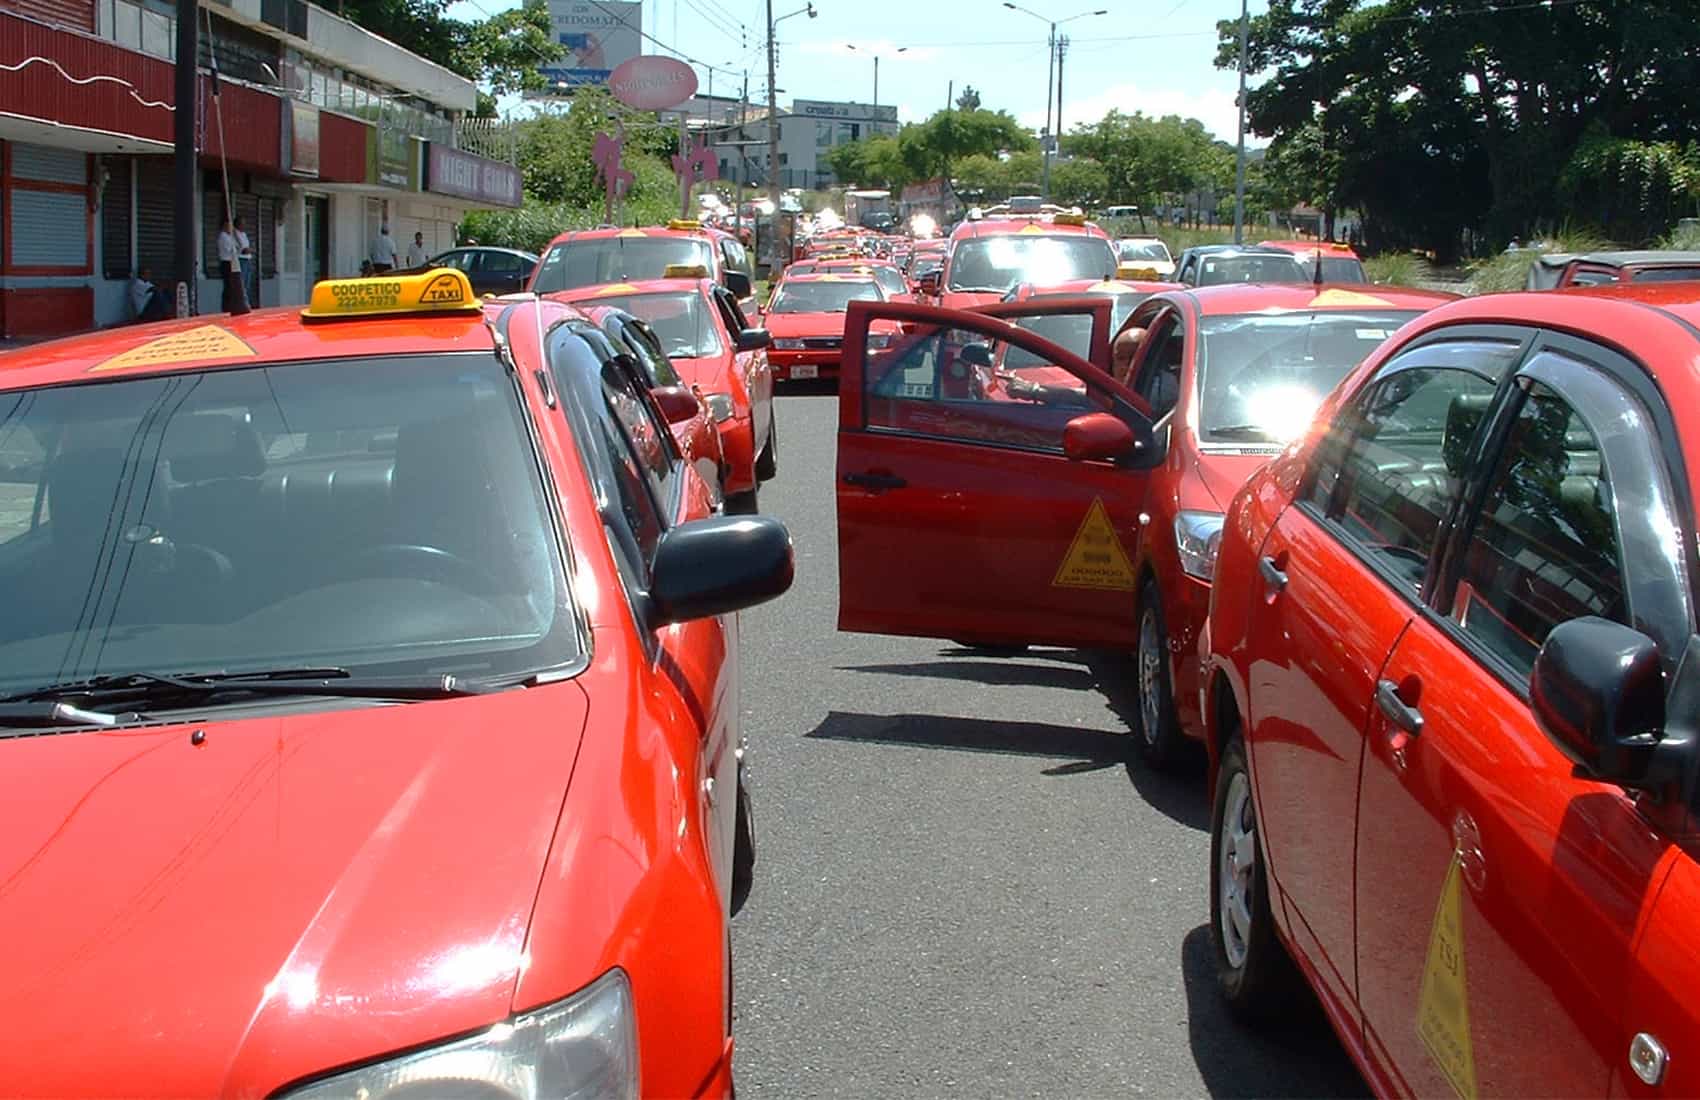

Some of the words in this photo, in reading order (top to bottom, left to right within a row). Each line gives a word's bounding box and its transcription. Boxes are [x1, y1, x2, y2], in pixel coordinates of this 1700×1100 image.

[440, 153, 480, 192] NIGHT
[331, 282, 401, 297] COOPETICO
[431, 289, 459, 300] TAXI
